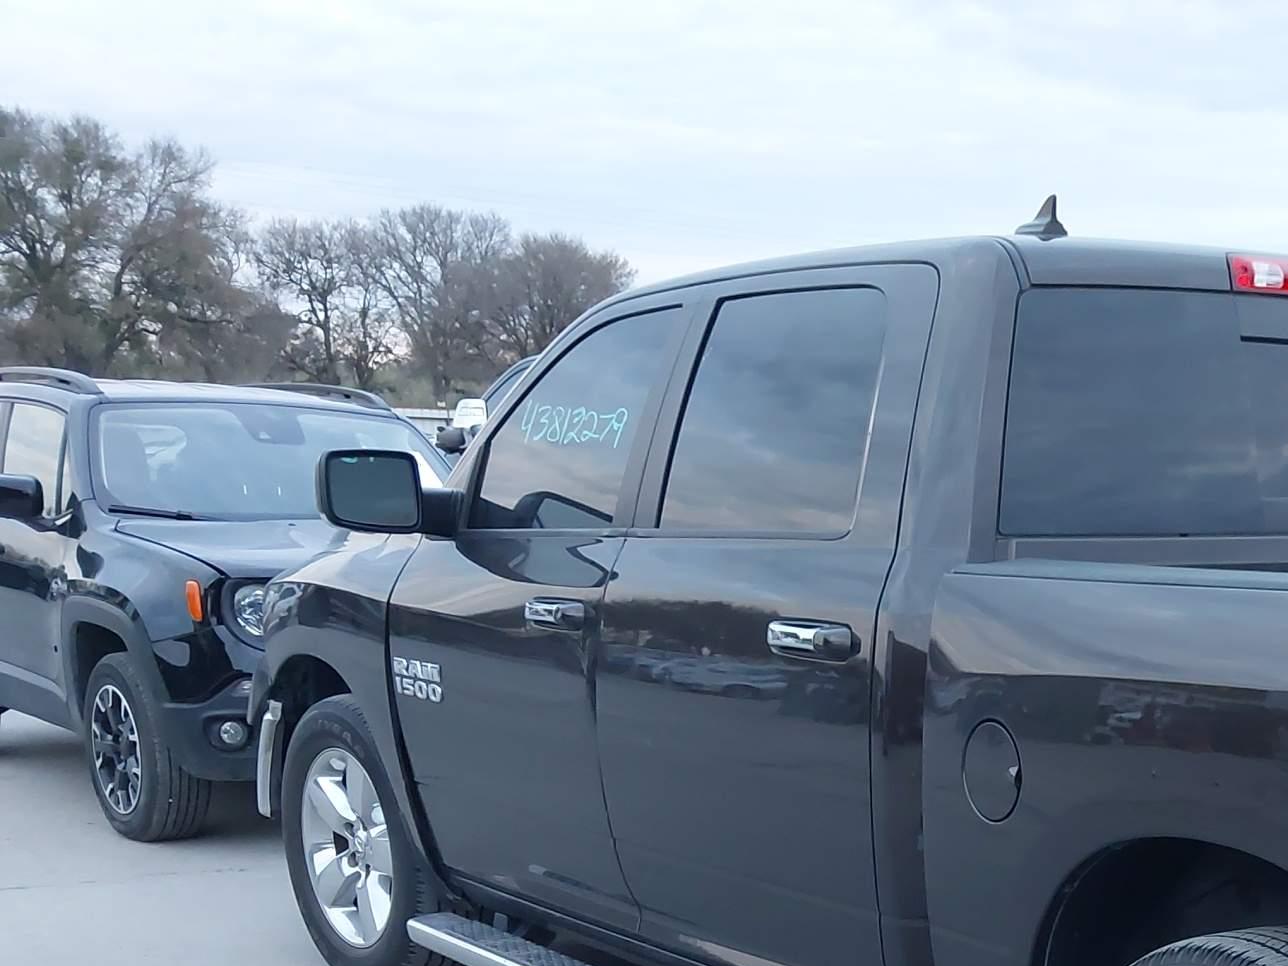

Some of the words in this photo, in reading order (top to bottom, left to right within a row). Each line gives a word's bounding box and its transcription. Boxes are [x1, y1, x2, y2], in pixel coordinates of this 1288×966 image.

[521, 400, 628, 449] 43812279
[393, 656, 441, 683] RAM
[395, 676, 442, 703] 1500
